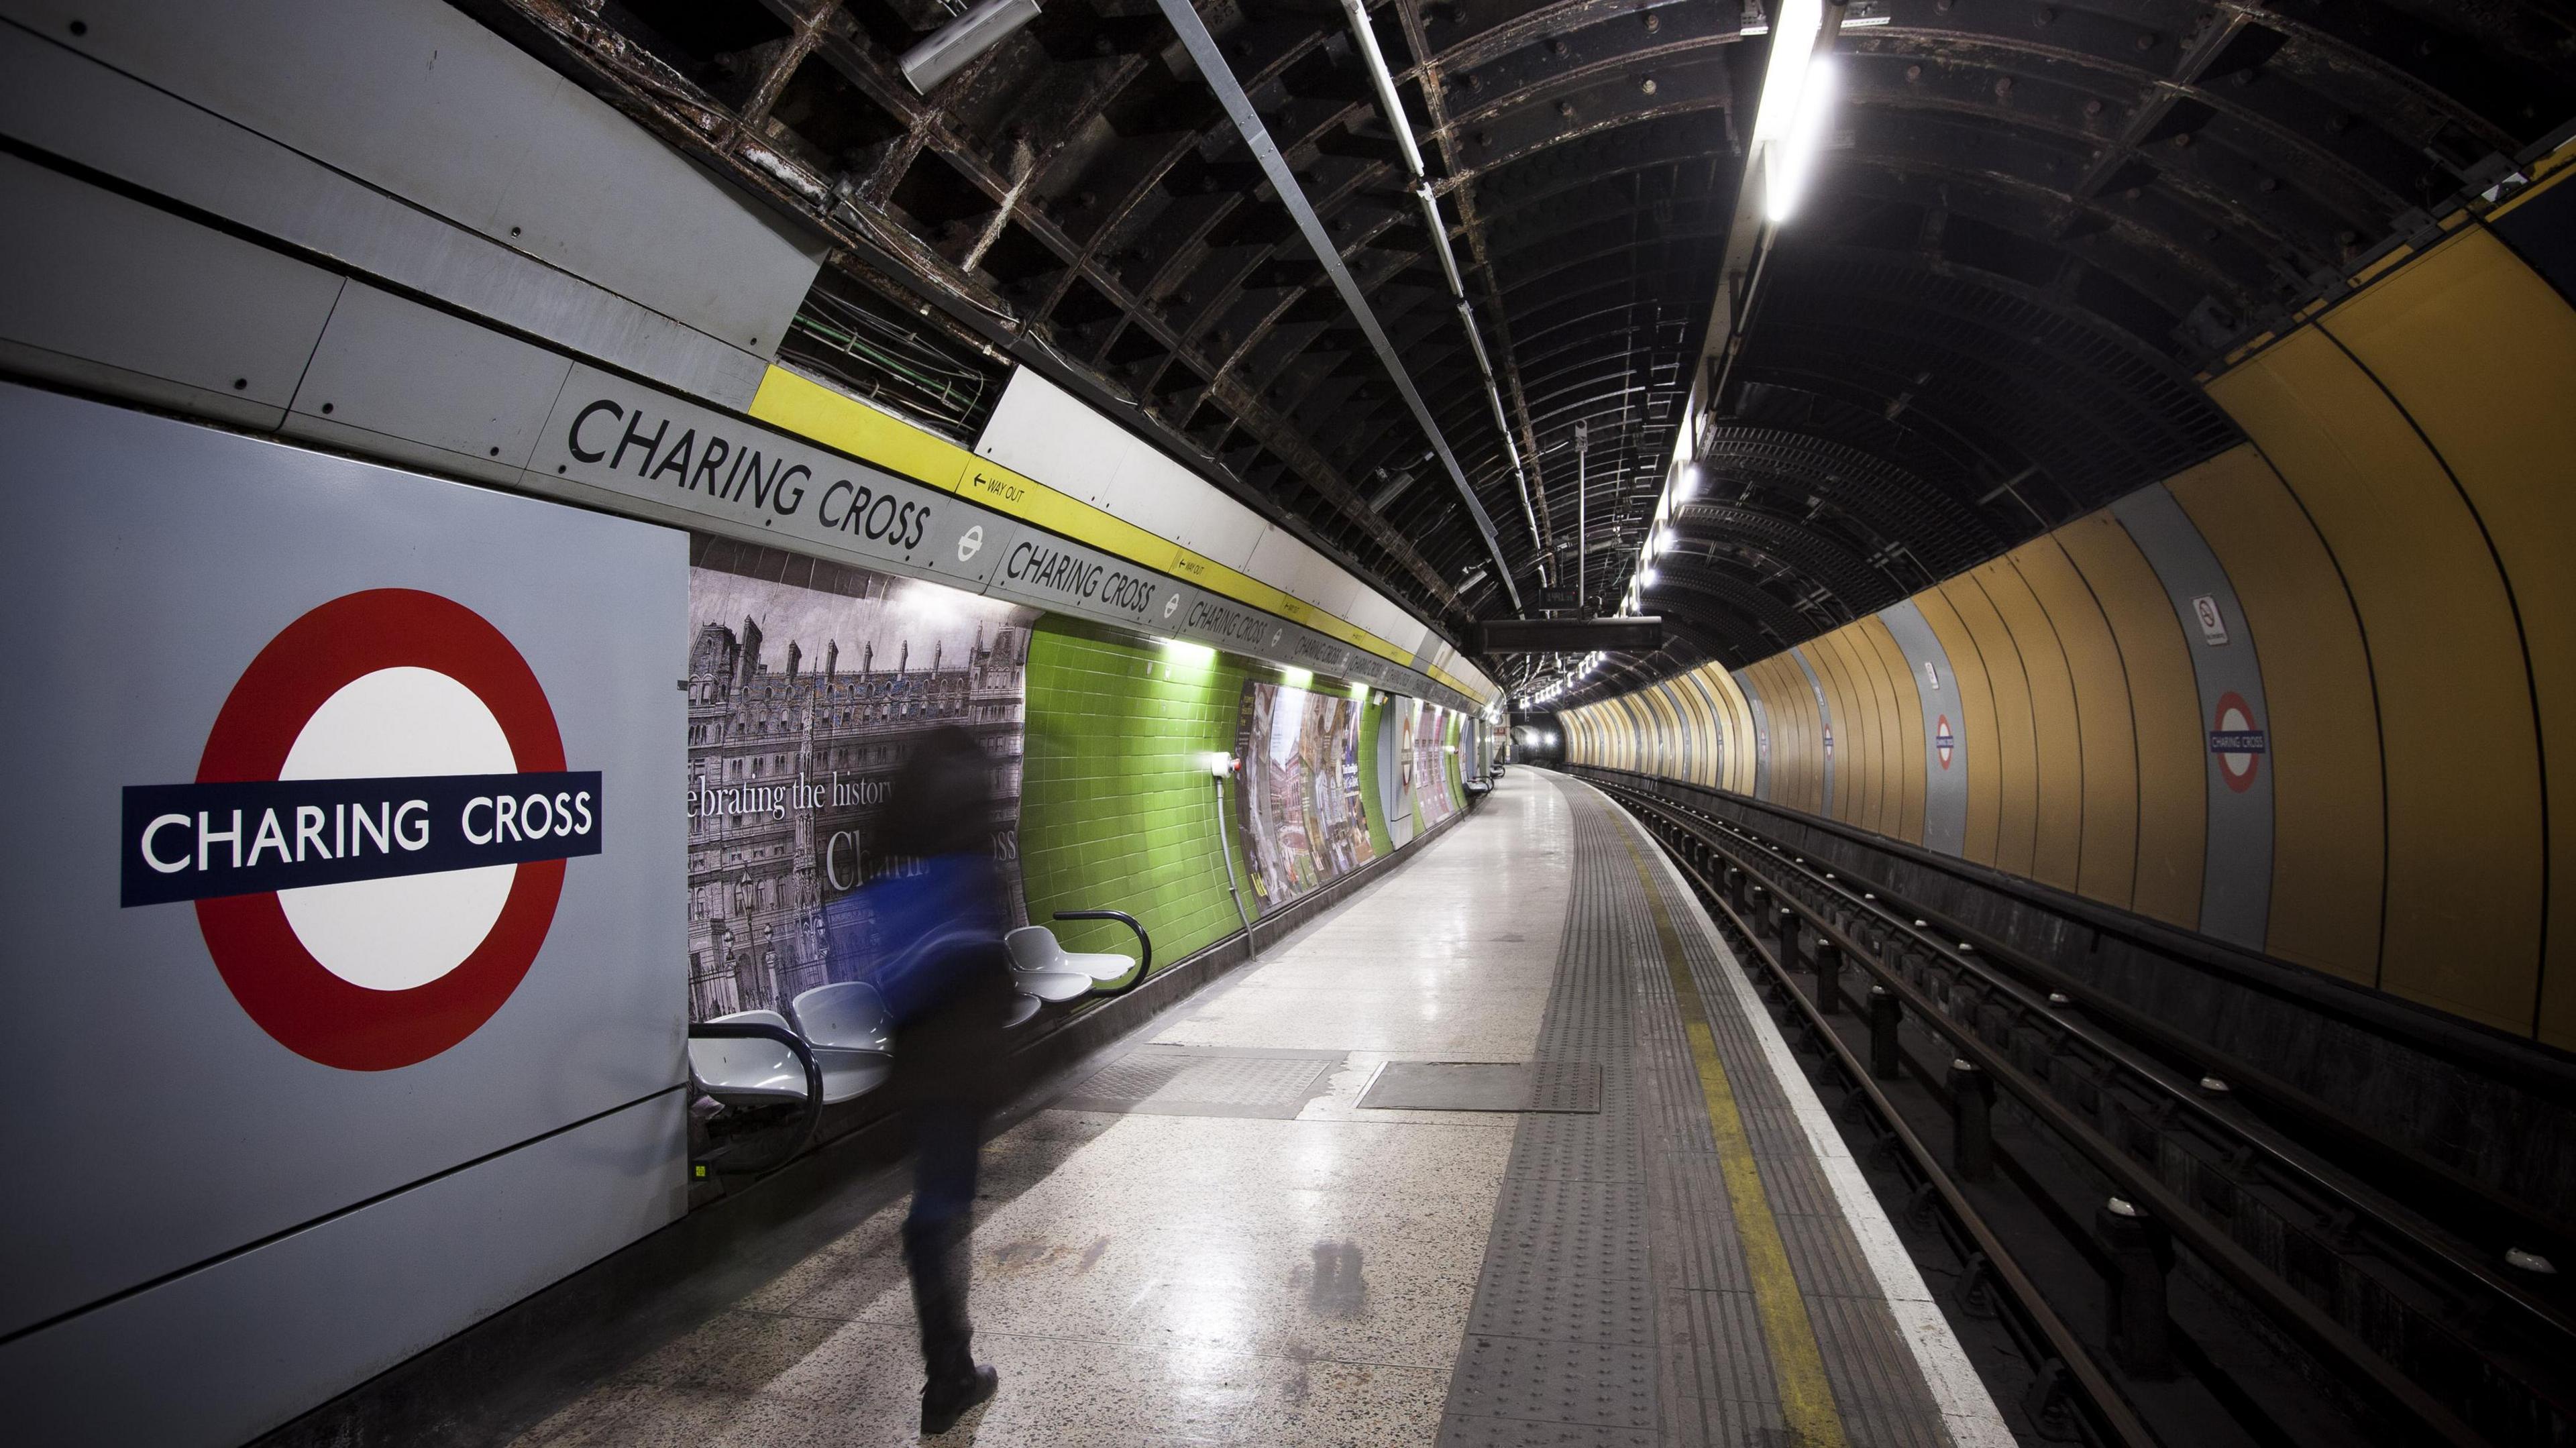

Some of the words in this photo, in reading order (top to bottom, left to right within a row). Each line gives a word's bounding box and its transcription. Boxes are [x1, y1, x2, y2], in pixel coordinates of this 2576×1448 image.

[568, 399, 812, 516] CHARING
[818, 479, 931, 551] CROSS
[987, 478, 1008, 496] WAY
[1005, 486, 1025, 503] OUT
[1007, 541, 1104, 598] CHARING
[1101, 571, 1156, 613] CROSS
[1188, 600, 1240, 636] CHARING
[1236, 616, 1269, 644] CROSS
[2212, 736, 2241, 748] CHARING
[2242, 736, 2263, 748] CROSS
[792, 771, 826, 810] the
[140, 799, 429, 874] CHARING
[462, 791, 592, 845] CROSS
